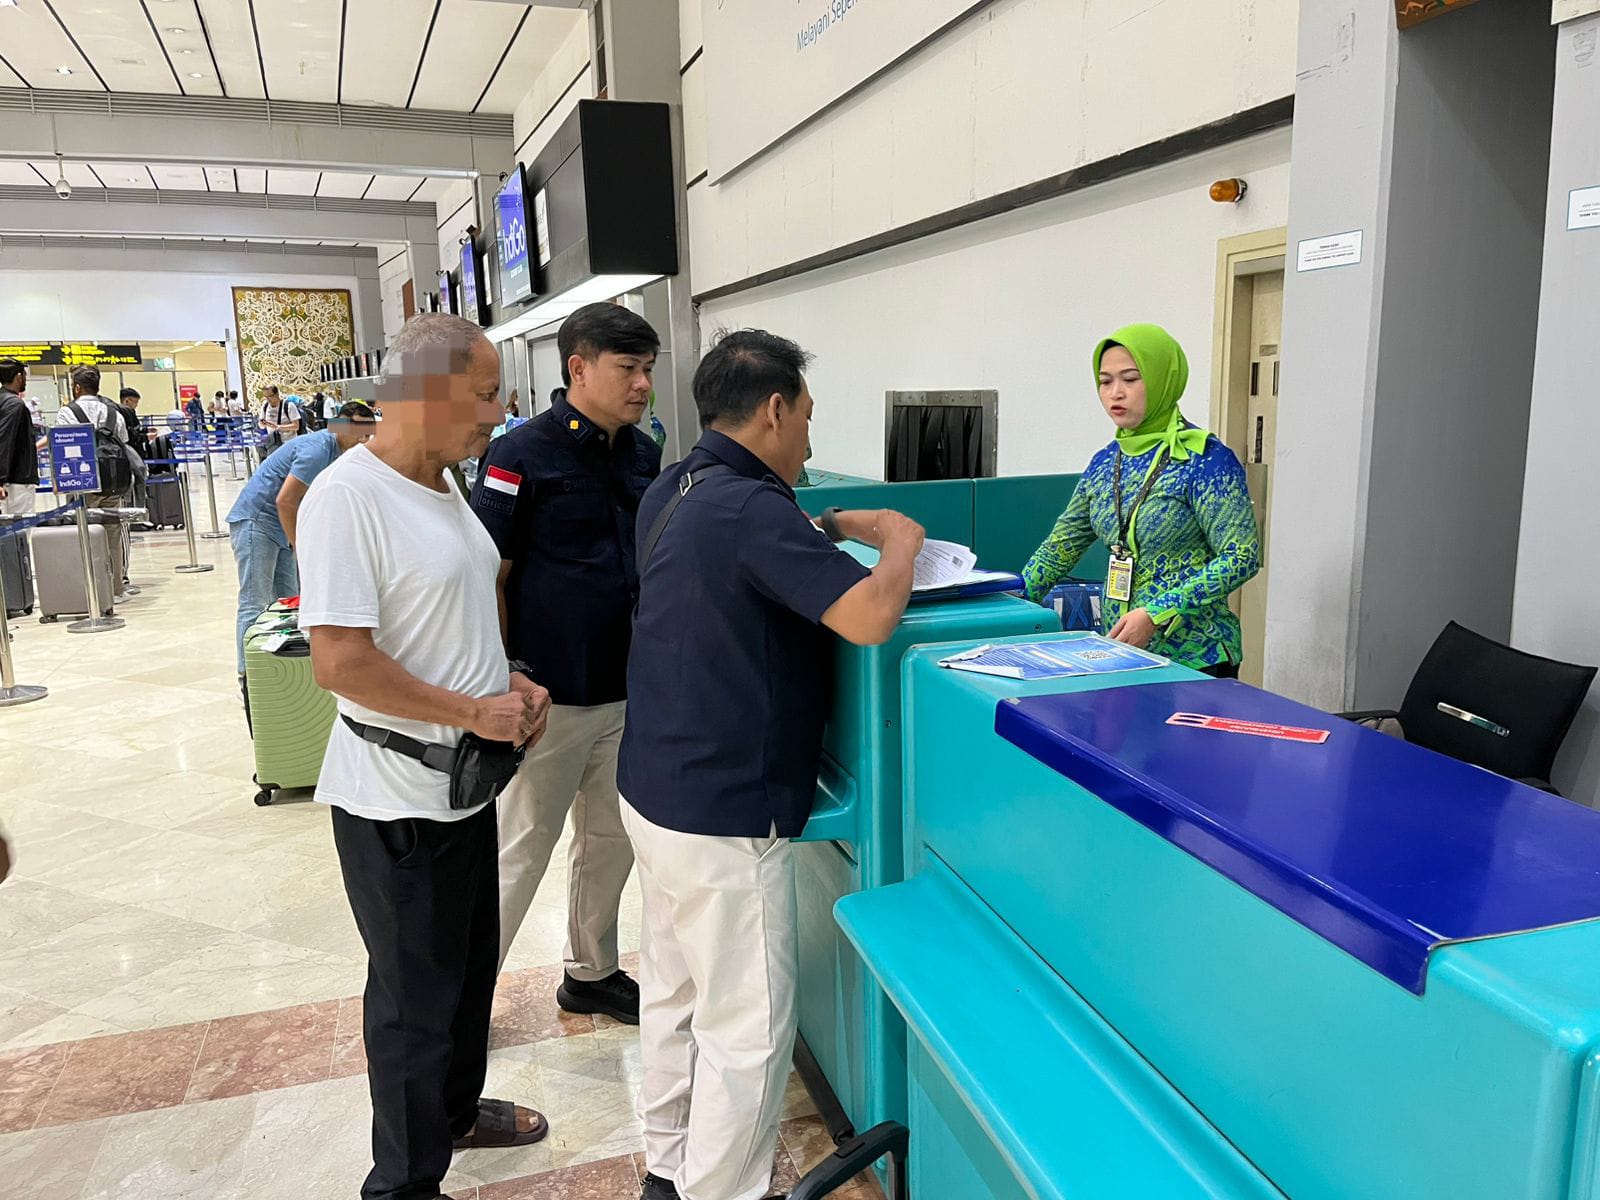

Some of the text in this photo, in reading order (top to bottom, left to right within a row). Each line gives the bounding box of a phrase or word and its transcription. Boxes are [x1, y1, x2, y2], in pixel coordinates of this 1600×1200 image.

[797, 5, 830, 52] Melayani
[502, 217, 525, 264] IndiGo
[59, 479, 81, 487] IndiGo
